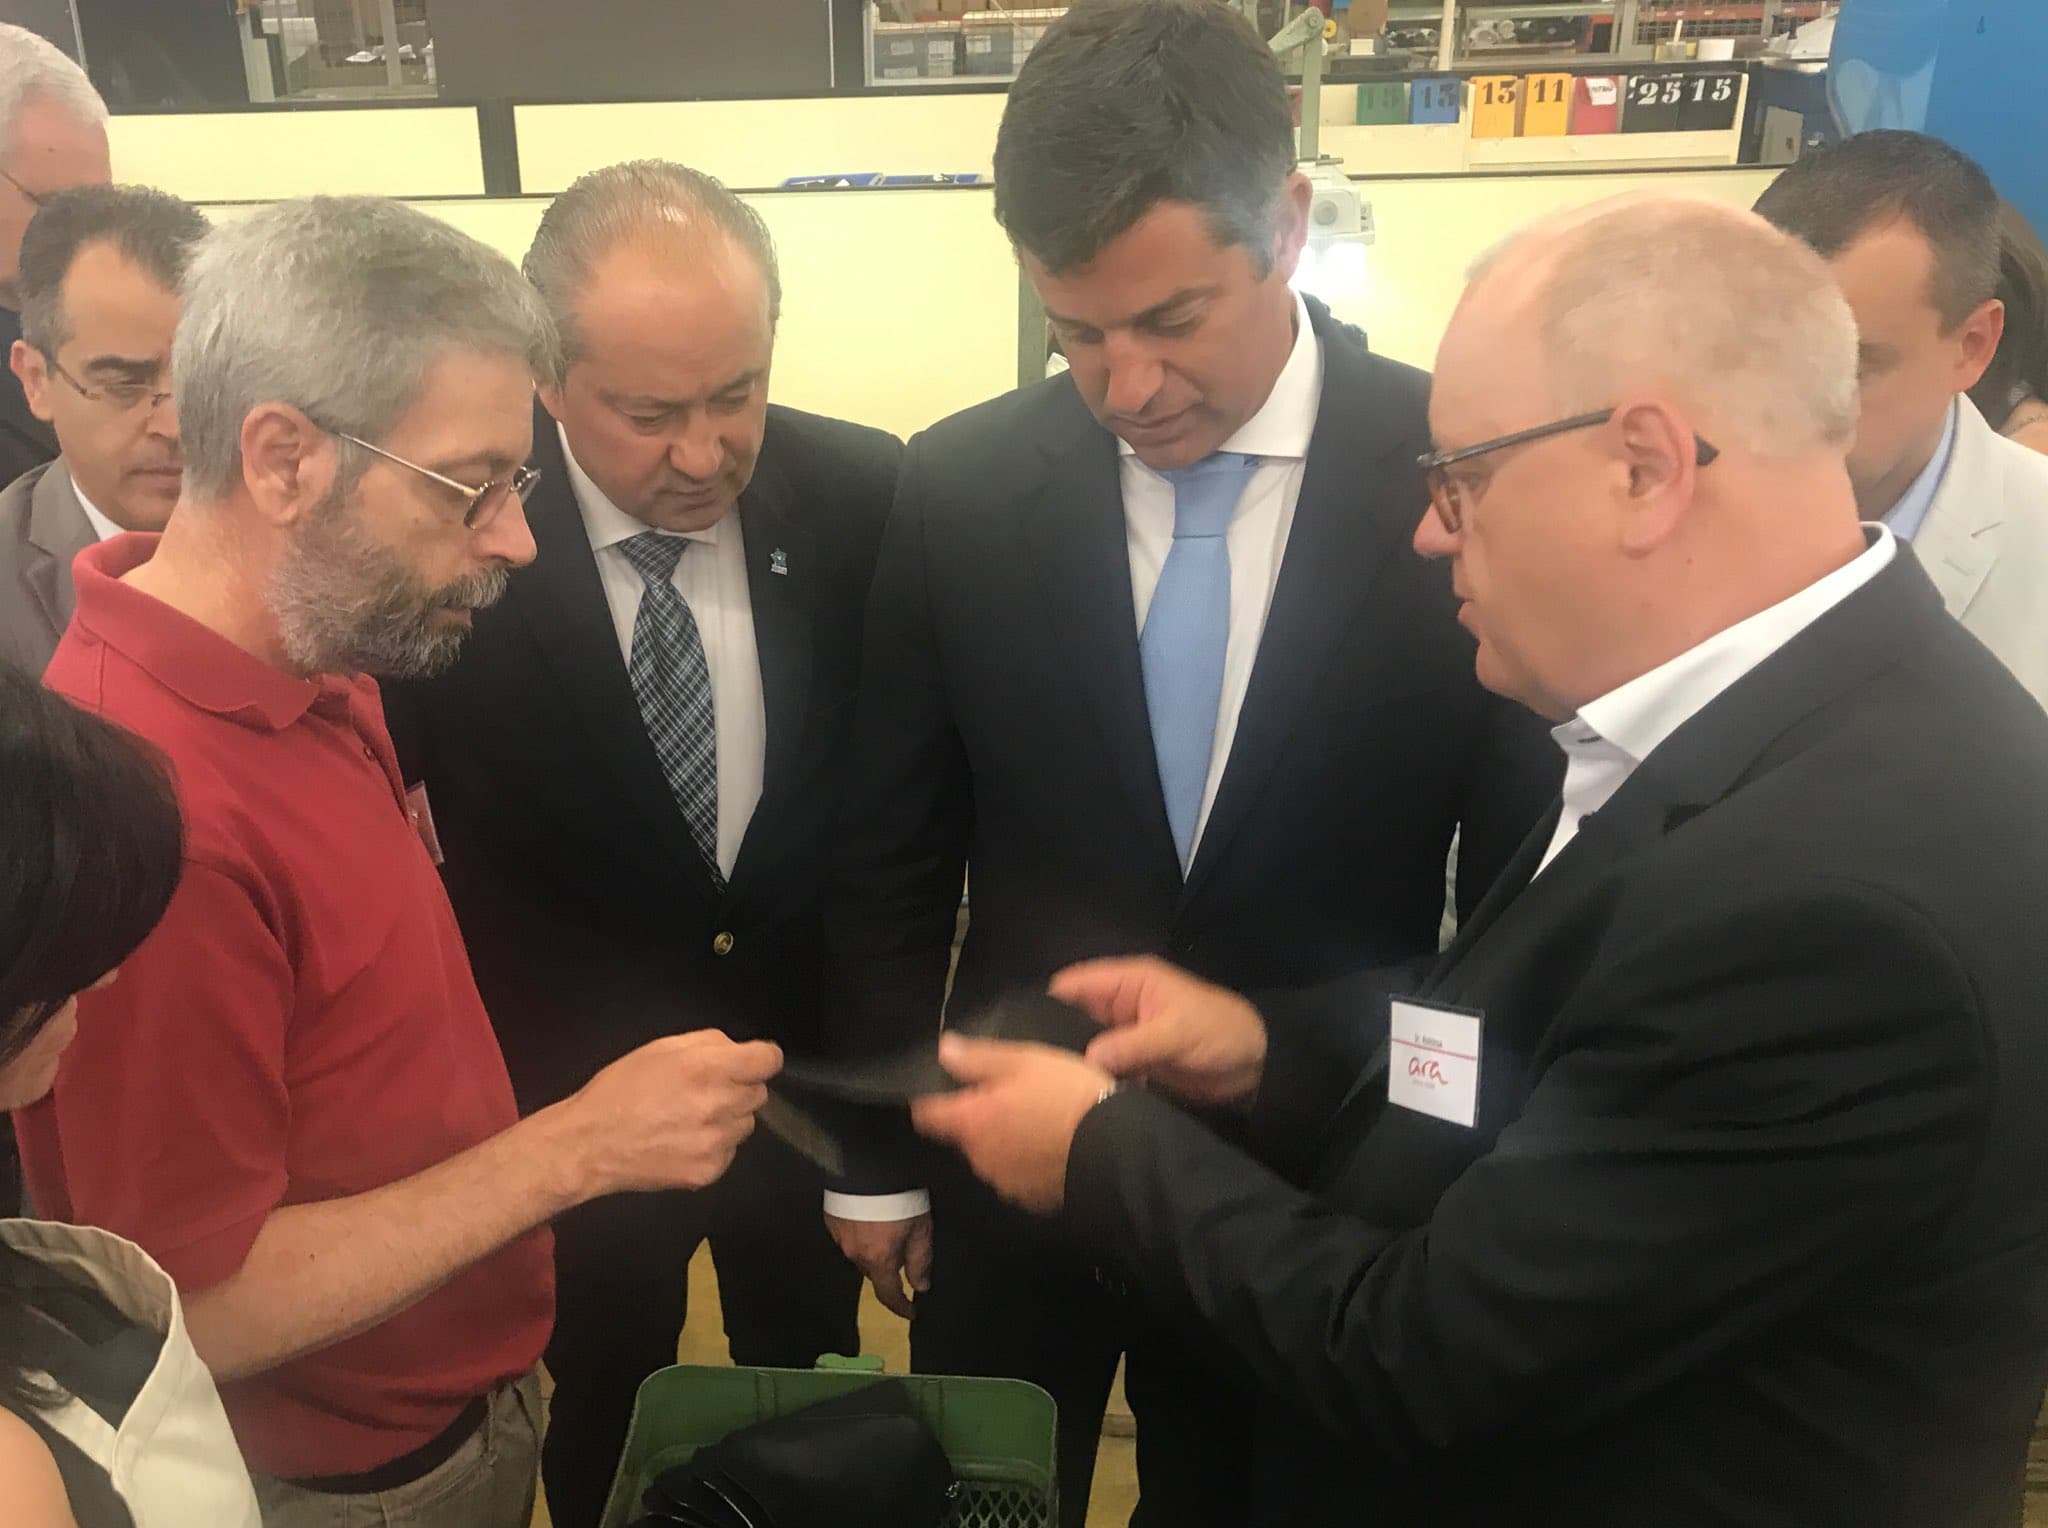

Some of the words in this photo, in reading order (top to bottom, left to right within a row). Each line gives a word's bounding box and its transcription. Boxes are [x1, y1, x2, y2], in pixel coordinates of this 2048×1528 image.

[1534, 79, 1563, 103] 11
[1637, 82, 1681, 105] 25
[1690, 78, 1731, 102] 15
[1408, 1056, 1449, 1085] ara
